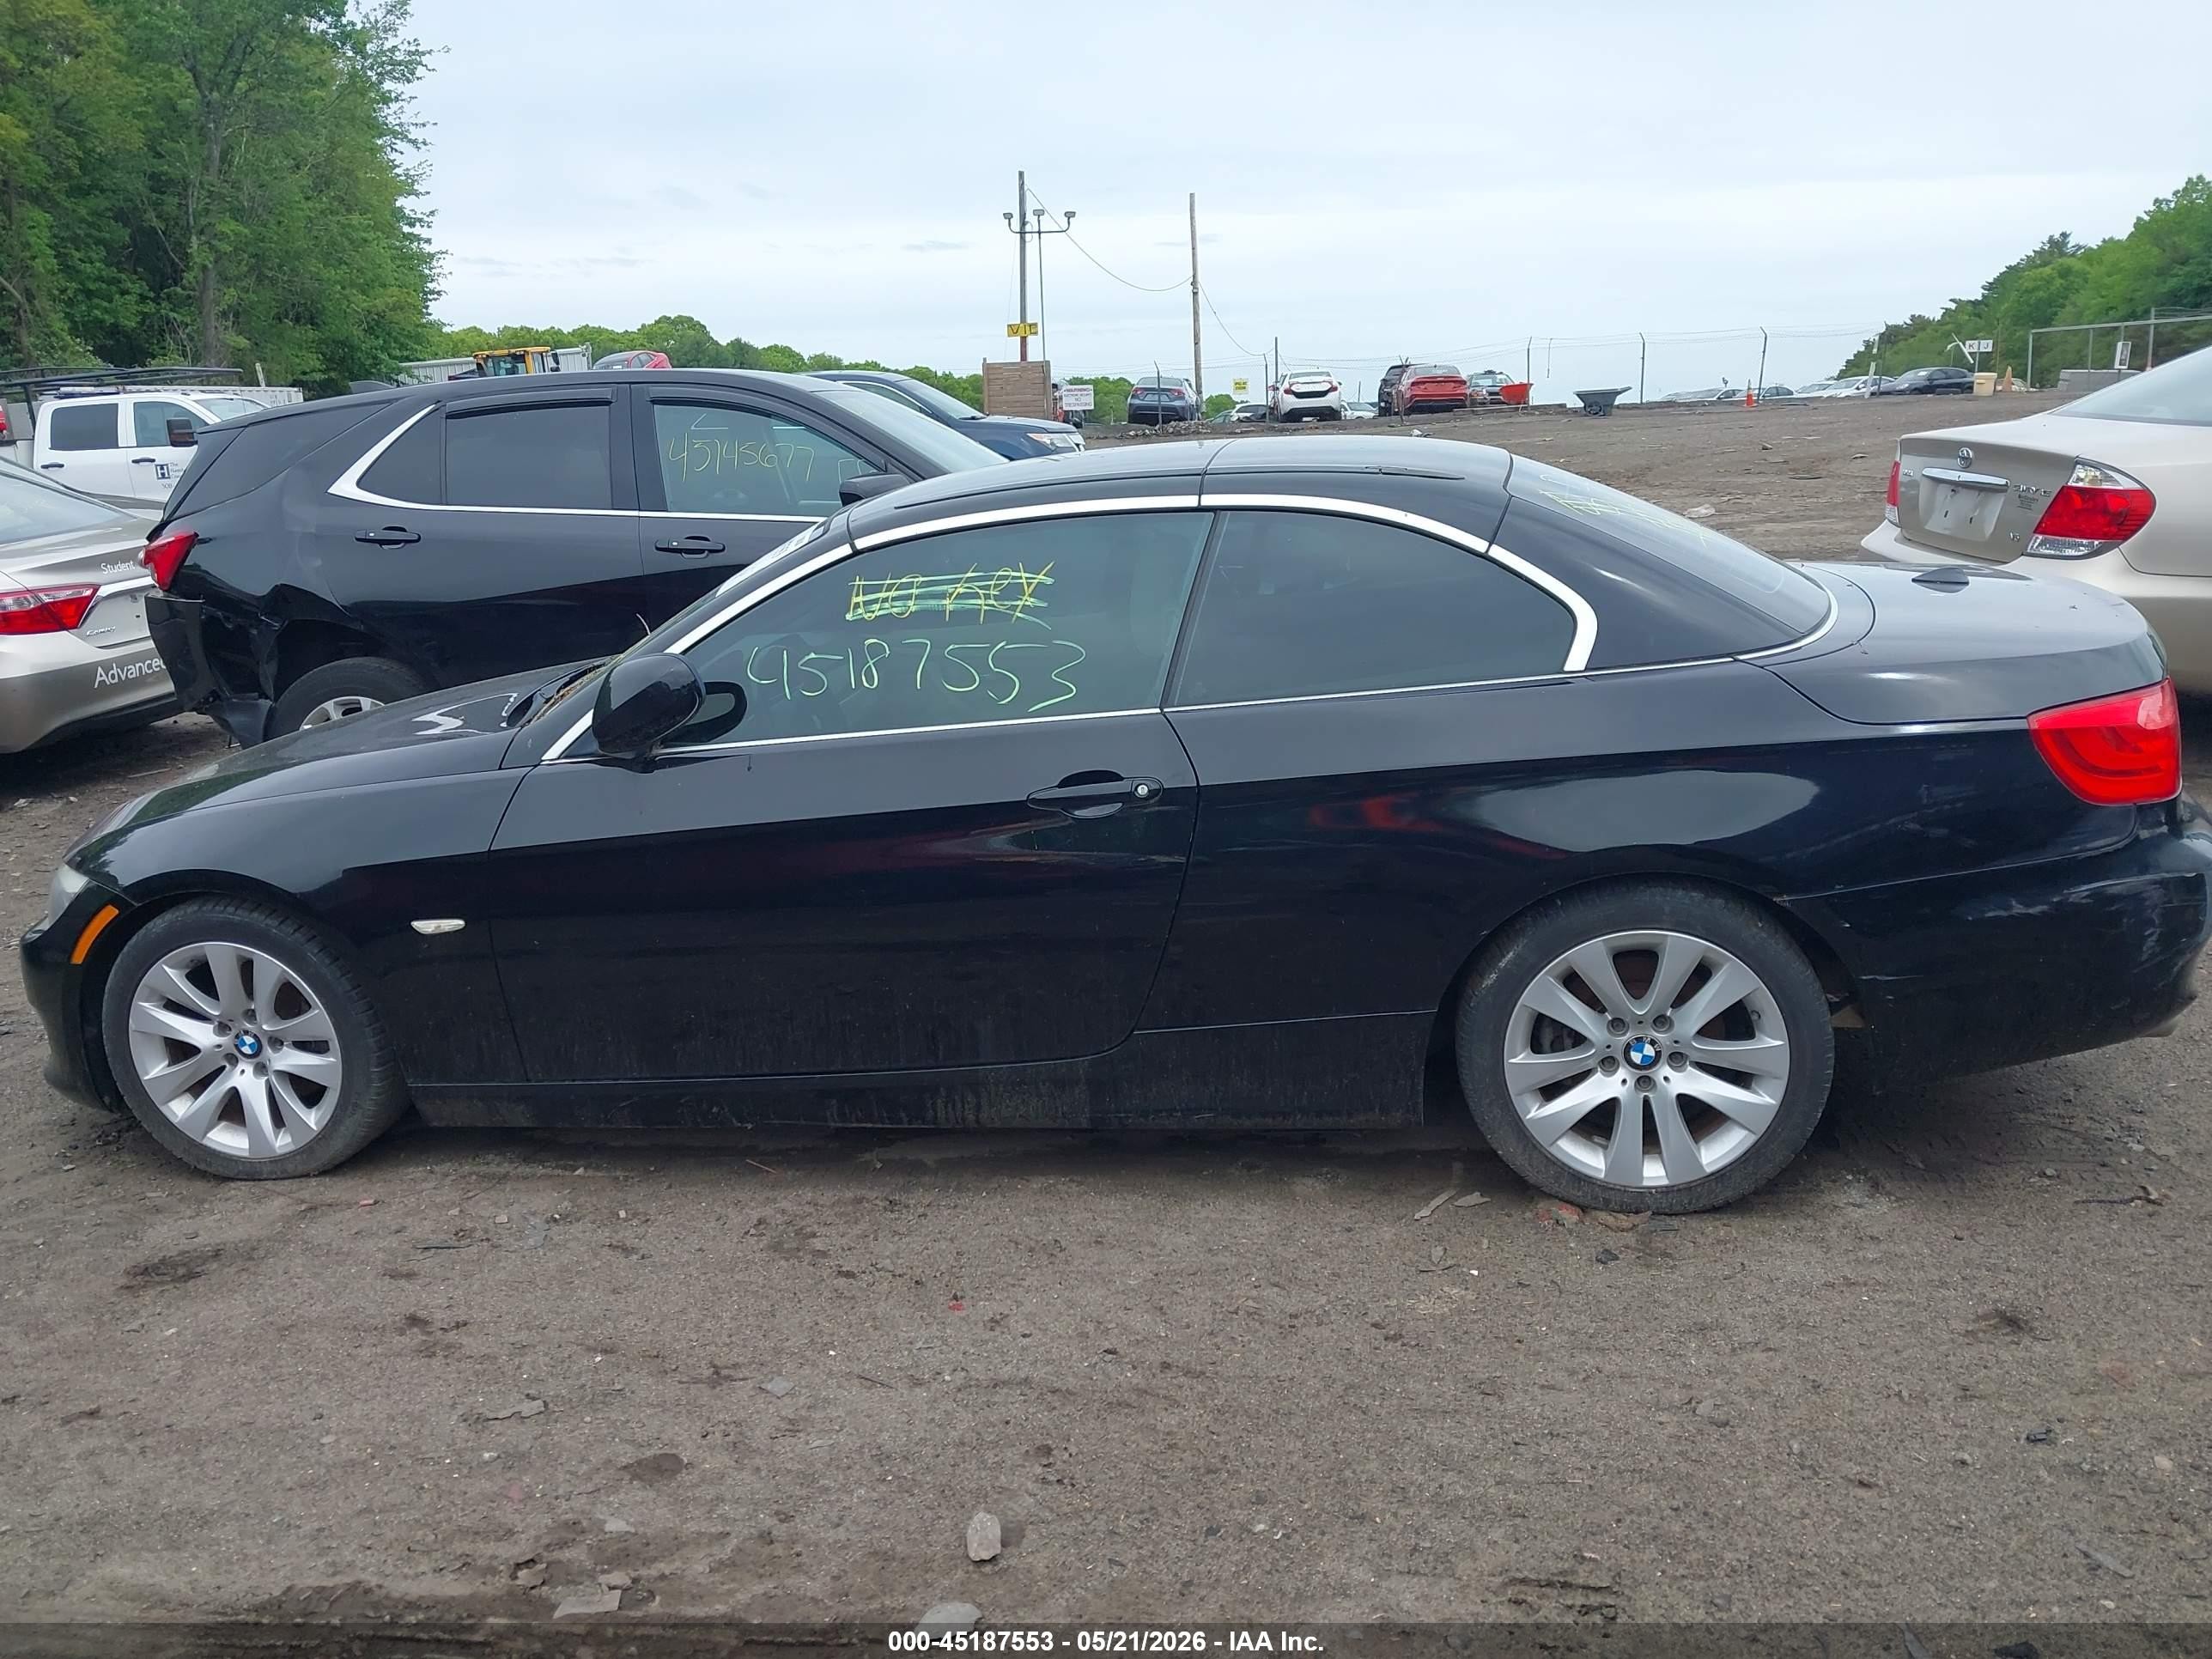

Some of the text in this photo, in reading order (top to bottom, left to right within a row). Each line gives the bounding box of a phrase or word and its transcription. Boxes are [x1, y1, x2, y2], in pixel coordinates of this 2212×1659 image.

[668, 432, 815, 482] 45145677
[100, 560, 136, 574] Student
[747, 638, 1086, 713] 45187553
